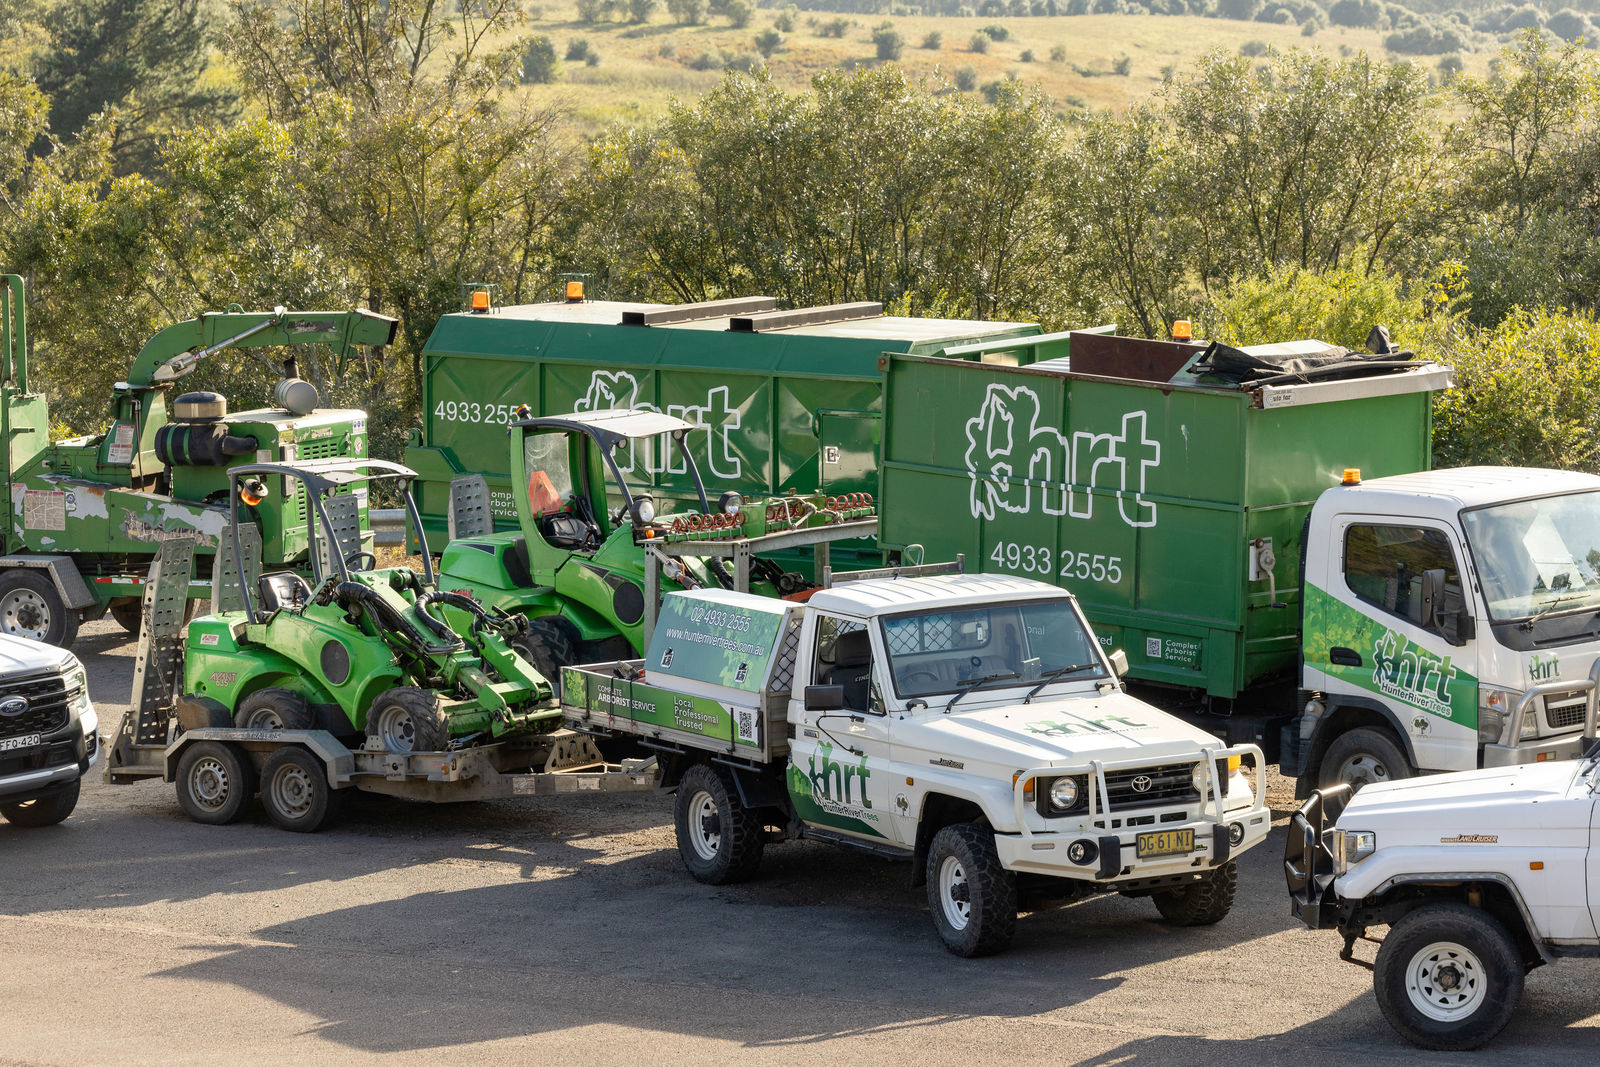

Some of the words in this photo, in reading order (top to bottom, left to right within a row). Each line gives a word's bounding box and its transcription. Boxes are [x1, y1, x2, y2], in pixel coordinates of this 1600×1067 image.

[434, 400, 481, 423] 4933
[484, 403, 522, 425] 255
[964, 383, 1160, 528] hrt
[990, 541, 1052, 575] 4933
[1060, 550, 1122, 584] 2555
[690, 606, 704, 623] 02
[704, 609, 727, 627] 4933
[727, 613, 752, 632] 2555
[1165, 639, 1199, 650] Complet
[1165, 646, 1197, 657] Arborist
[1165, 652, 1192, 663] Service
[1372, 628, 1457, 705] hrt
[208, 671, 238, 683] AVANT
[597, 693, 630, 708] ARBORIST
[631, 700, 656, 713] SERVICE
[673, 696, 694, 708] Local
[1381, 682, 1452, 717] HunterRiverTrees
[674, 706, 719, 724] Professional
[674, 715, 703, 731] Trusted
[808, 740, 872, 809] hrt
